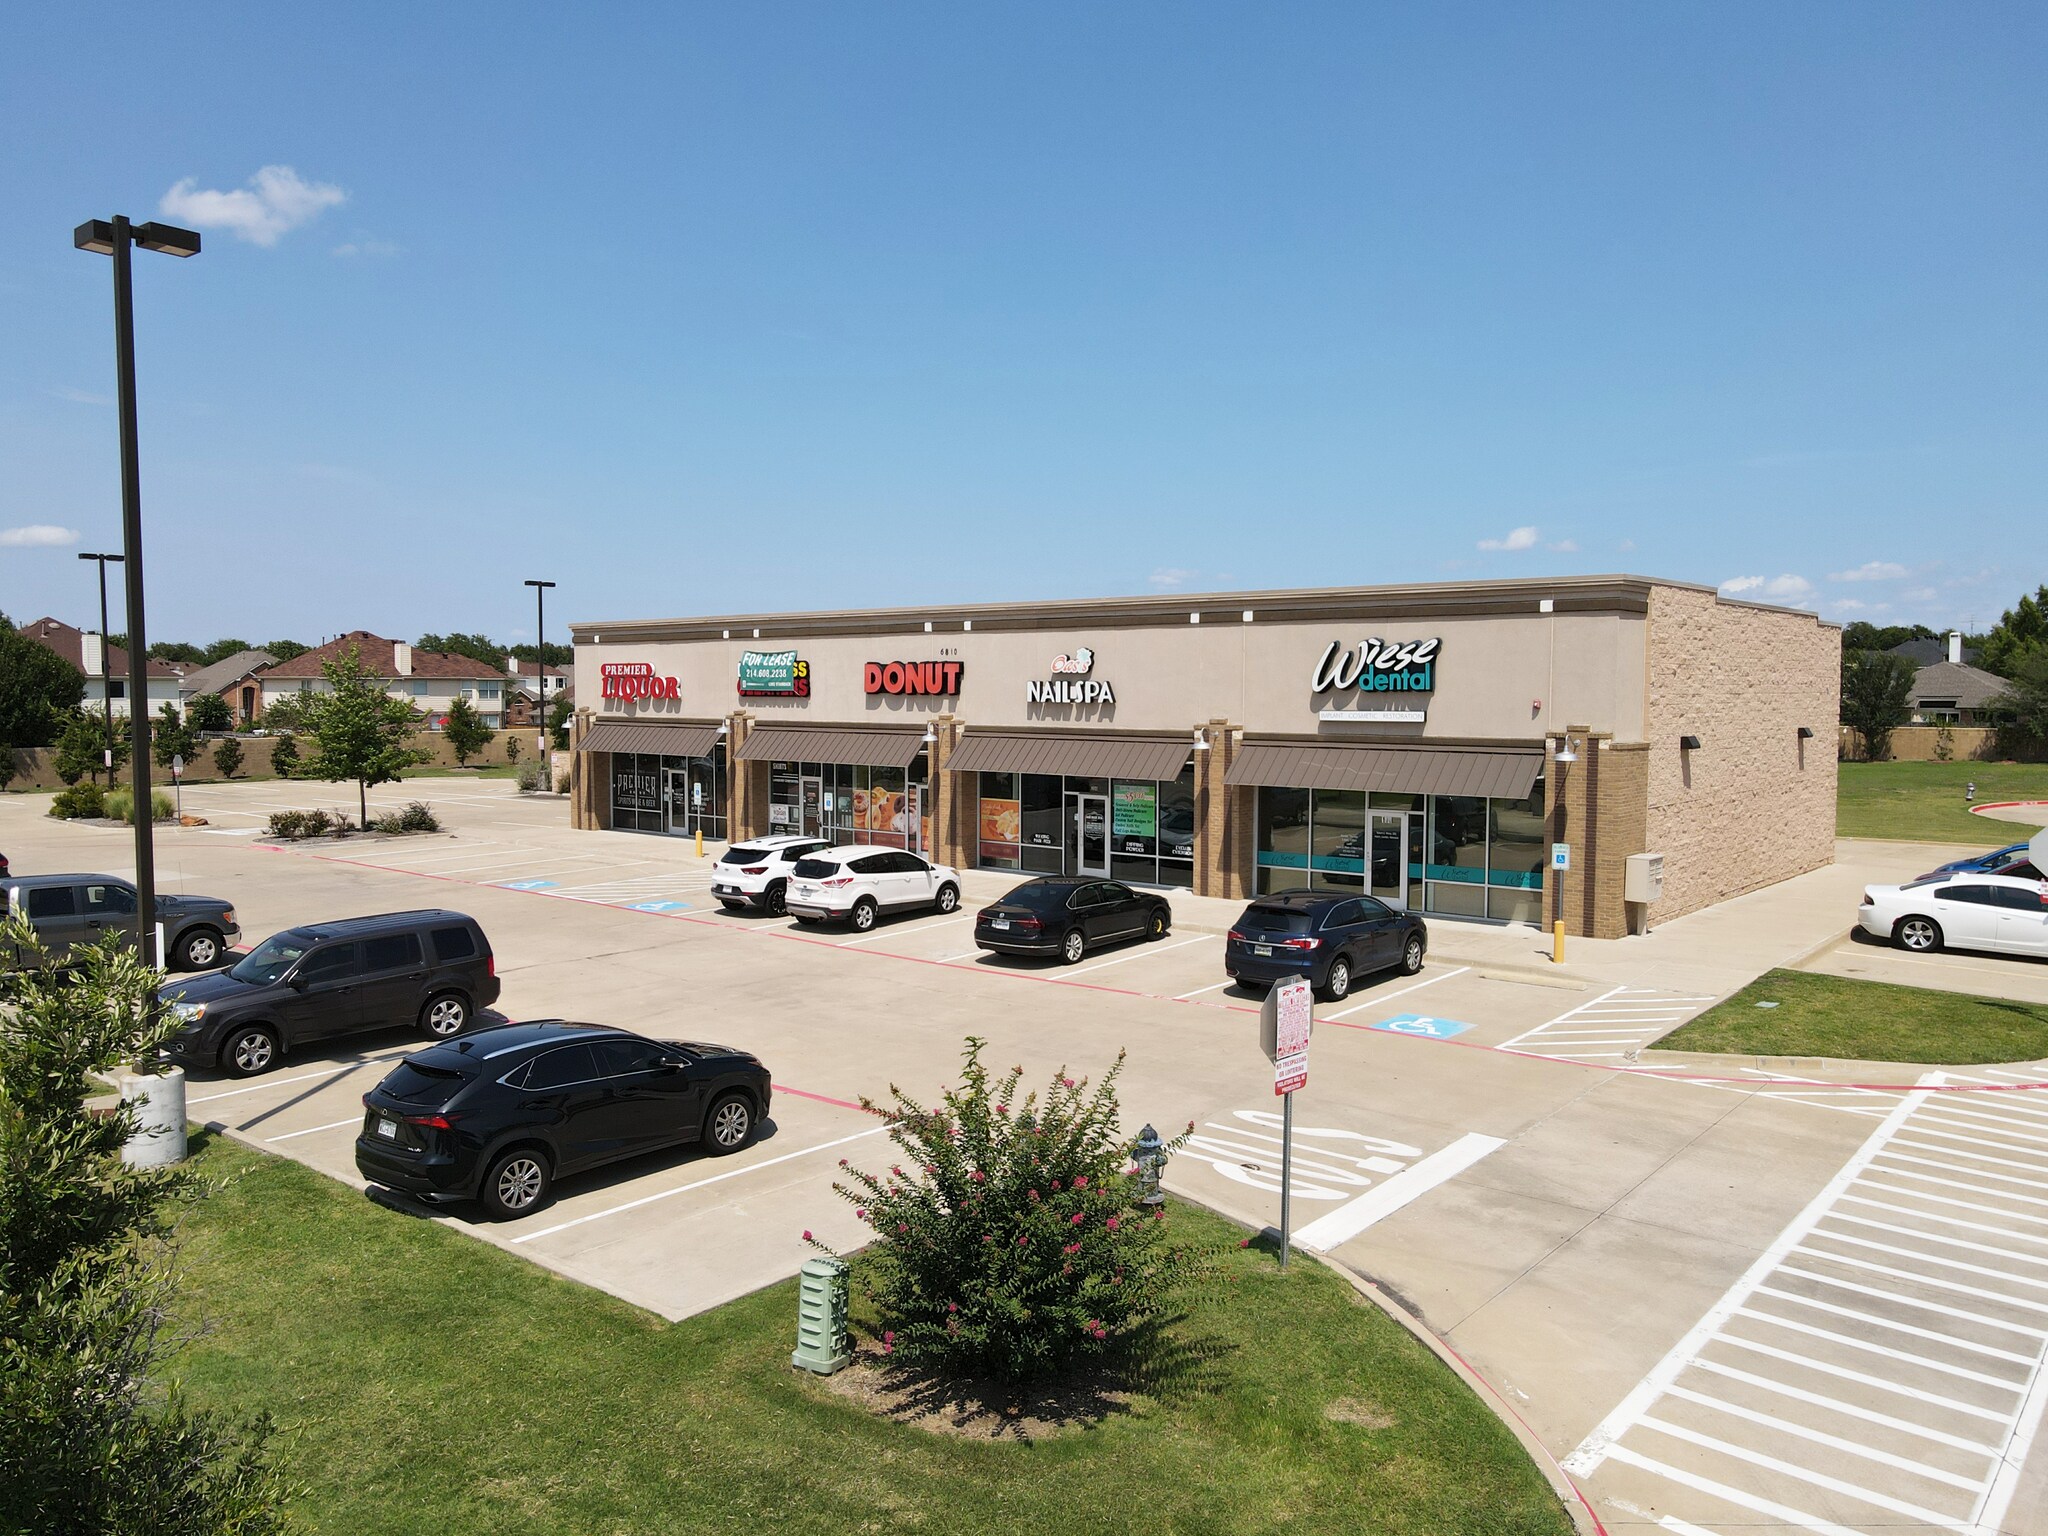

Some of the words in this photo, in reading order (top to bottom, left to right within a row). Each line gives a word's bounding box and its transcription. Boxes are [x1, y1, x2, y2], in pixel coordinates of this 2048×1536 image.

[742, 653, 762, 666] FOR
[763, 652, 795, 666] LEASE
[940, 648, 958, 656] 6810
[1311, 638, 1438, 692] Wiese
[605, 665, 647, 676] PREMIER
[864, 663, 960, 694] DONUT
[1358, 663, 1431, 691] dental
[601, 677, 679, 703] LIQUOR
[1026, 680, 1070, 703] NAIL
[1072, 681, 1114, 703] SPA
[1177, 1110, 1423, 1200] STOP
